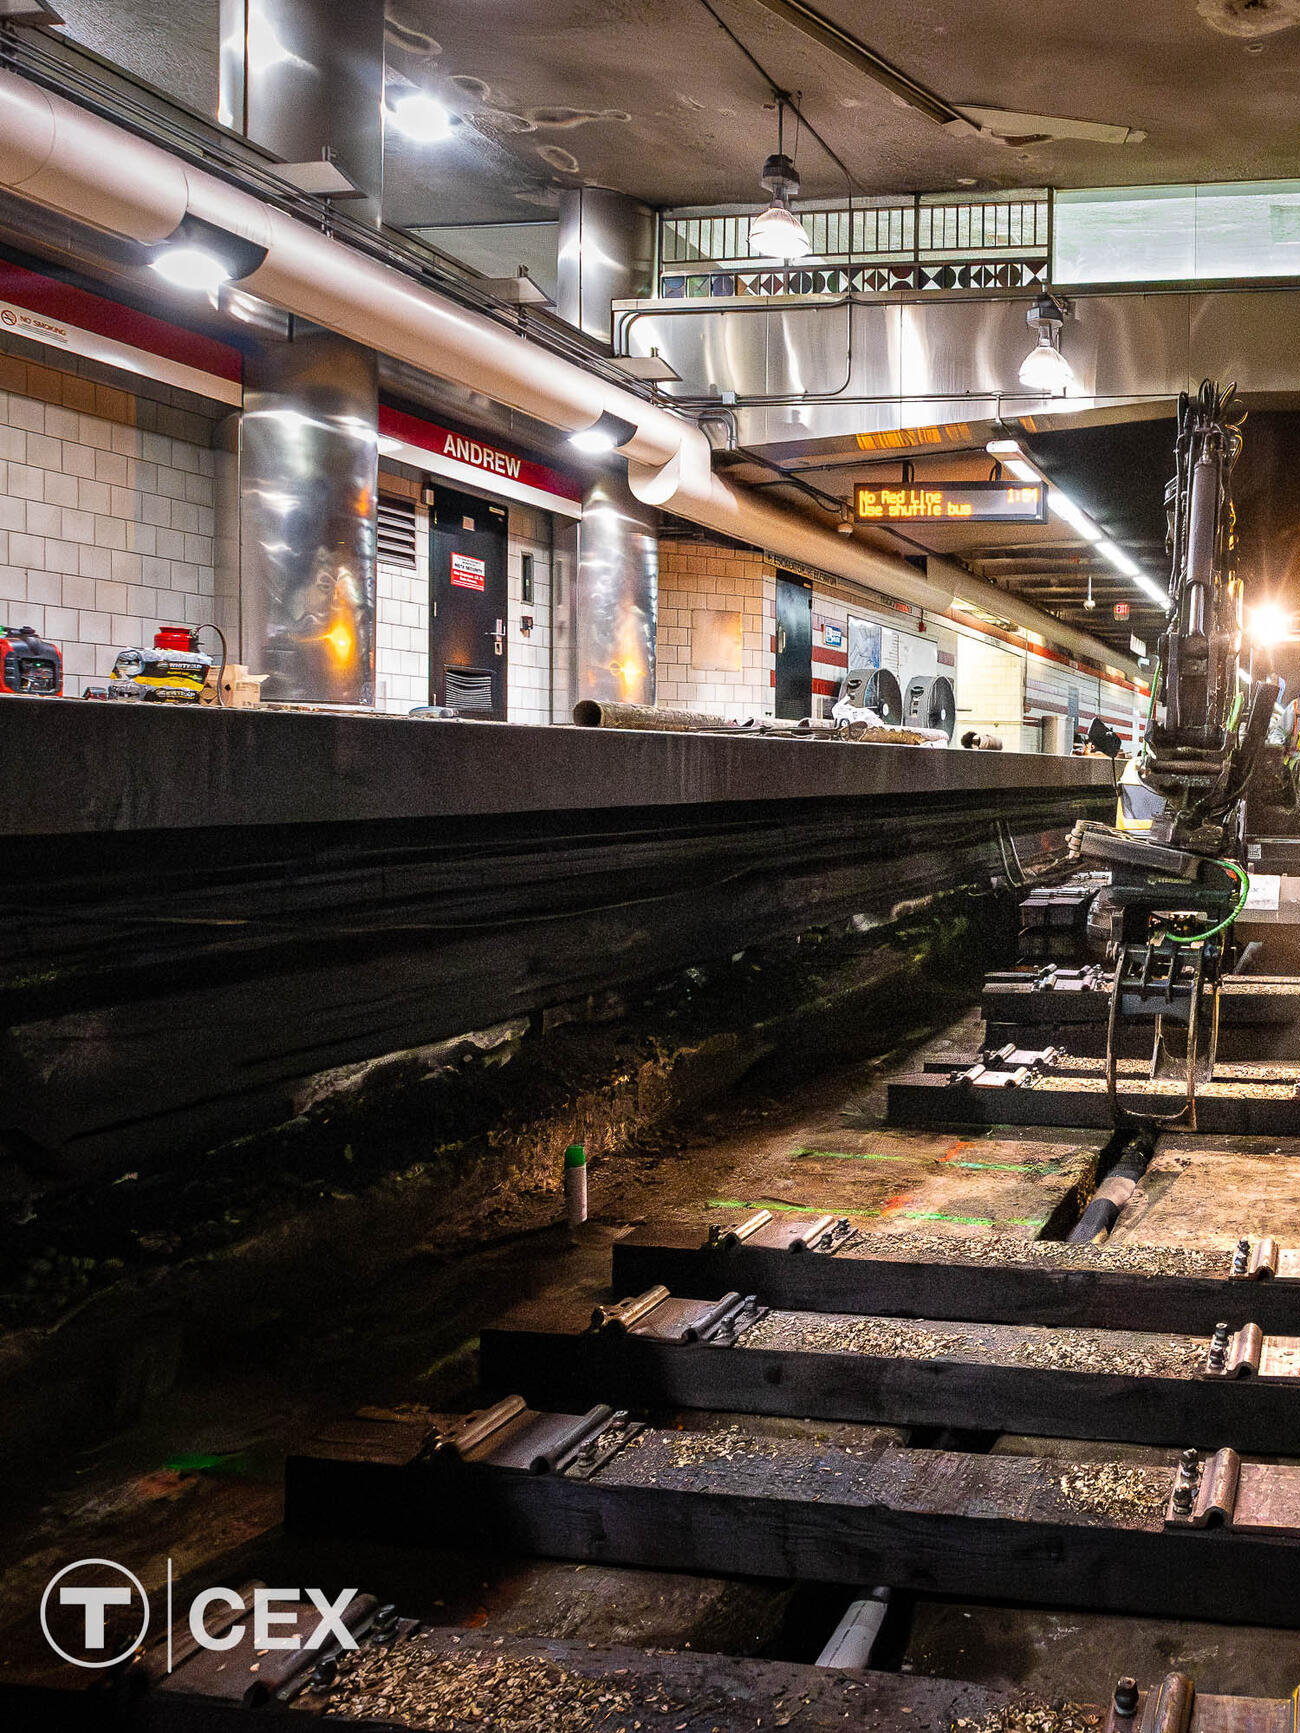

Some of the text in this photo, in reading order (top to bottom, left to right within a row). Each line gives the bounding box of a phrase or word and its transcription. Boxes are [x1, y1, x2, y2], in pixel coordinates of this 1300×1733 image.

[20, 315, 32, 325] NO
[443, 433, 521, 479] ANDREW
[859, 490, 876, 505] No
[881, 490, 905, 505] Red
[910, 490, 942, 505] Line
[859, 501, 973, 517] Use shuttle bus
[1116, 603, 1128, 615] EXIT
